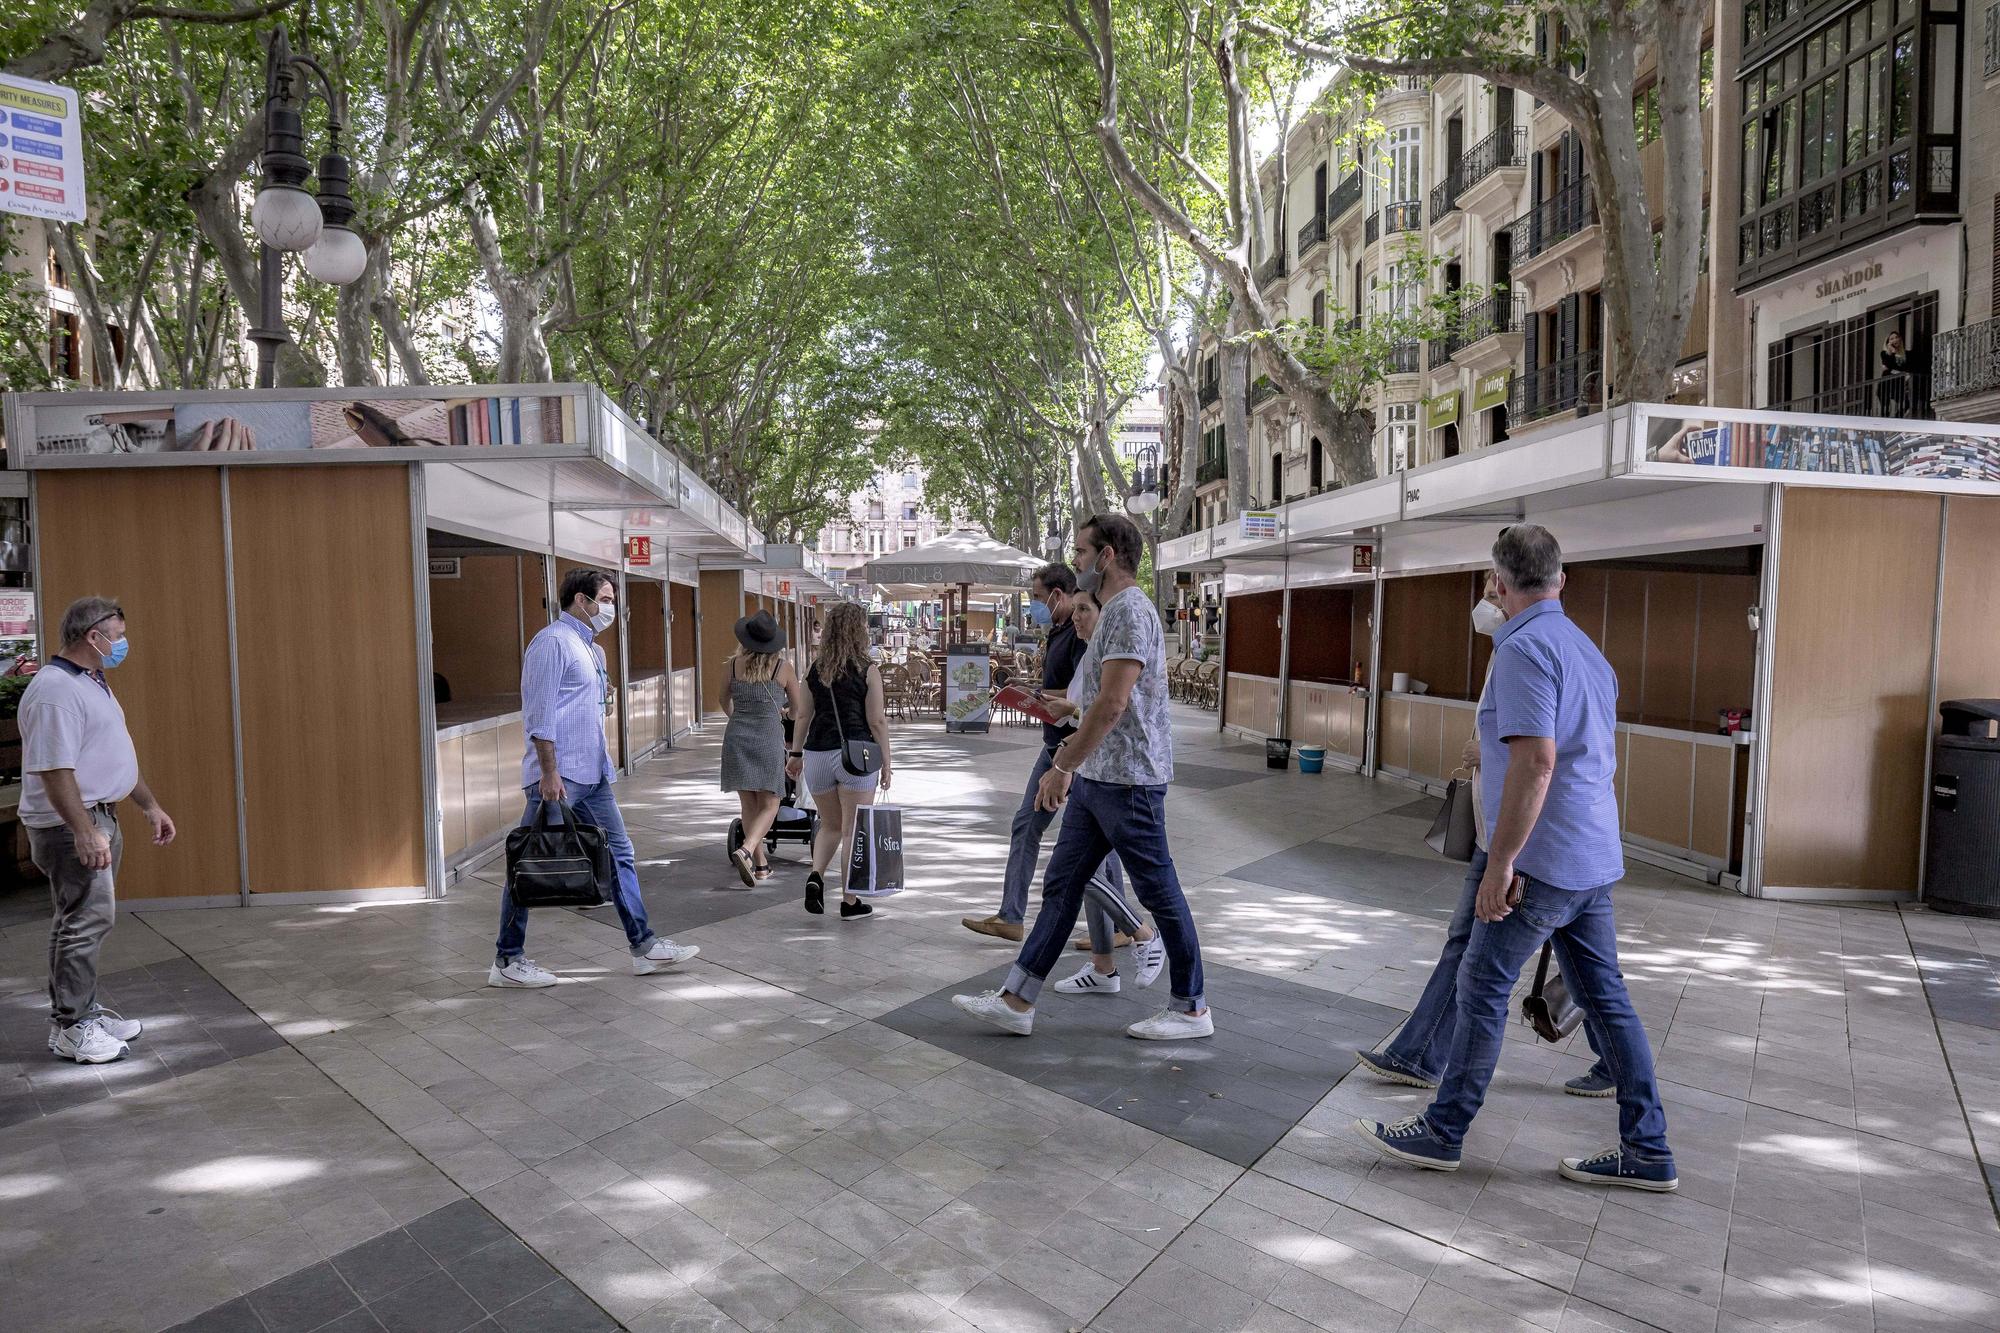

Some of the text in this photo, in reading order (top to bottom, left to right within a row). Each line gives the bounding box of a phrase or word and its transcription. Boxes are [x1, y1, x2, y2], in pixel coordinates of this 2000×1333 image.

[1406, 488, 1420, 503] FNAC
[875, 566, 943, 582] BORN-8
[0, 598, 28, 606] ORDIC
